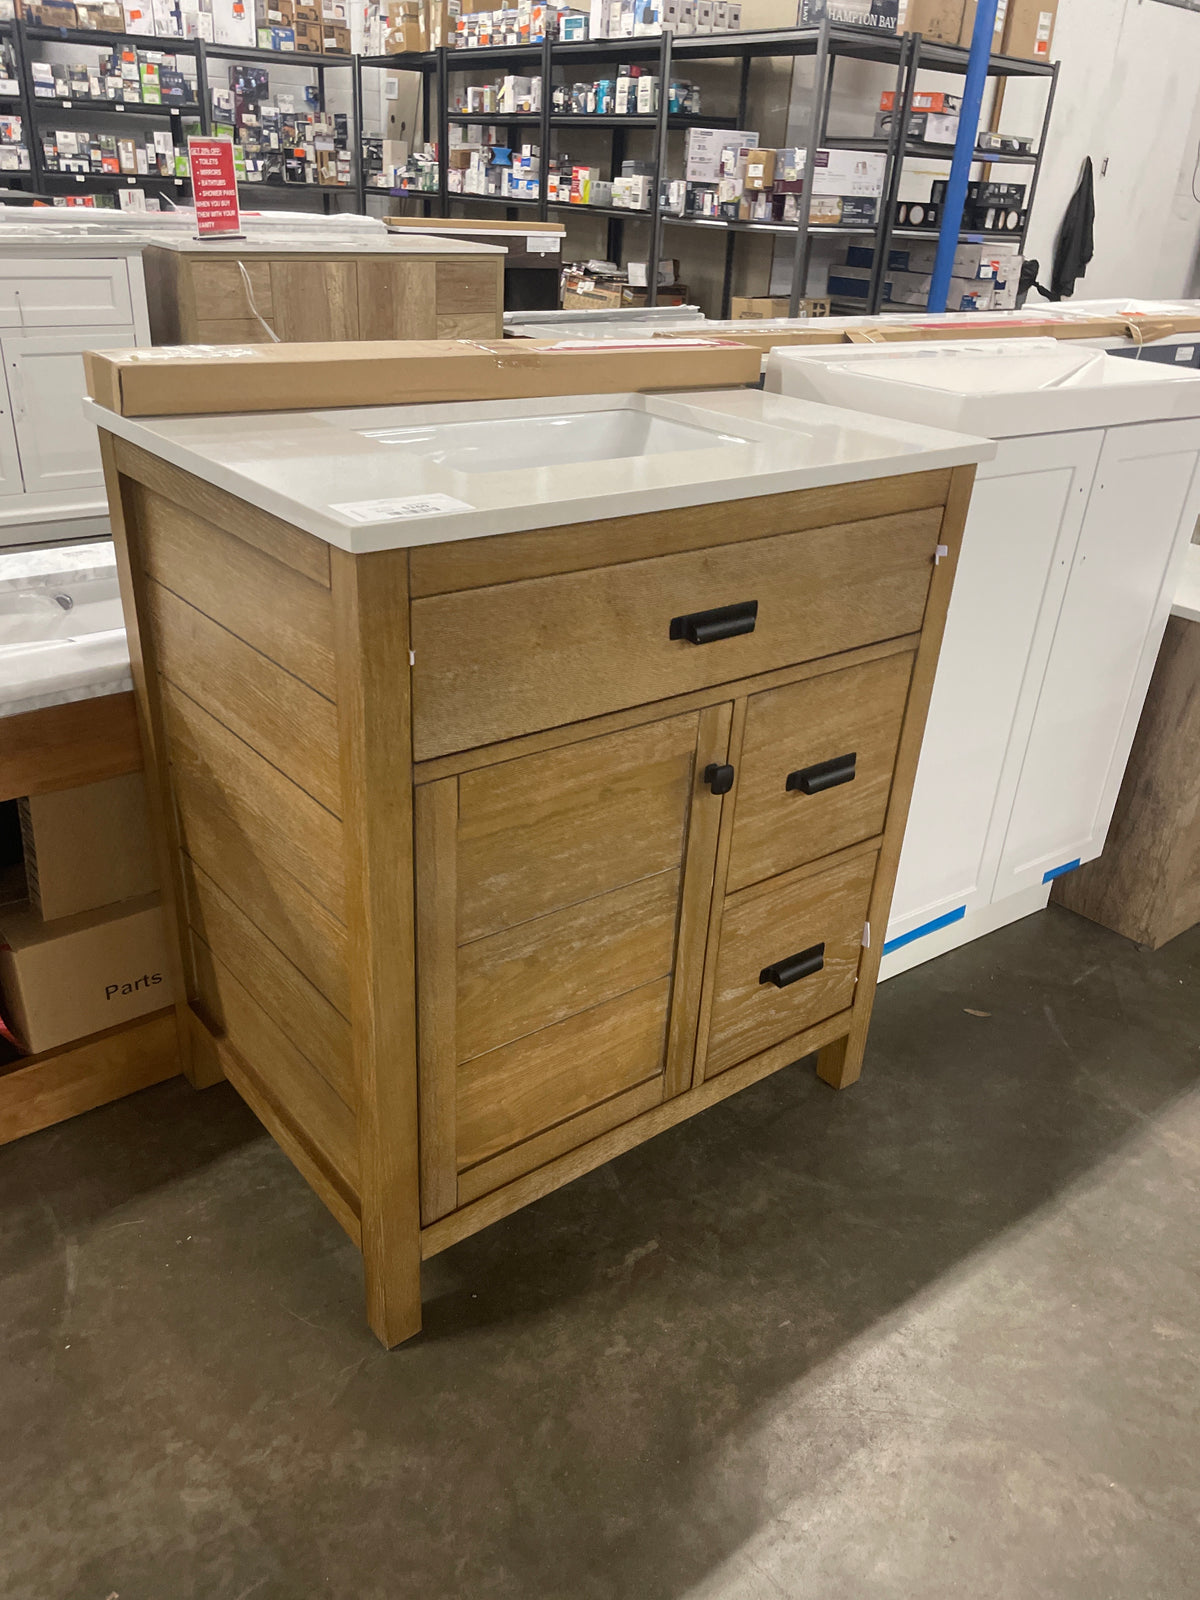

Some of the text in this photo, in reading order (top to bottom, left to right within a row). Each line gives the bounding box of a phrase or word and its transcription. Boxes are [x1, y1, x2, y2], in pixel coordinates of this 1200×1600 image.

[828, 8, 897, 29] HAMPTON BAY
[105, 973, 162, 1000] Parts
